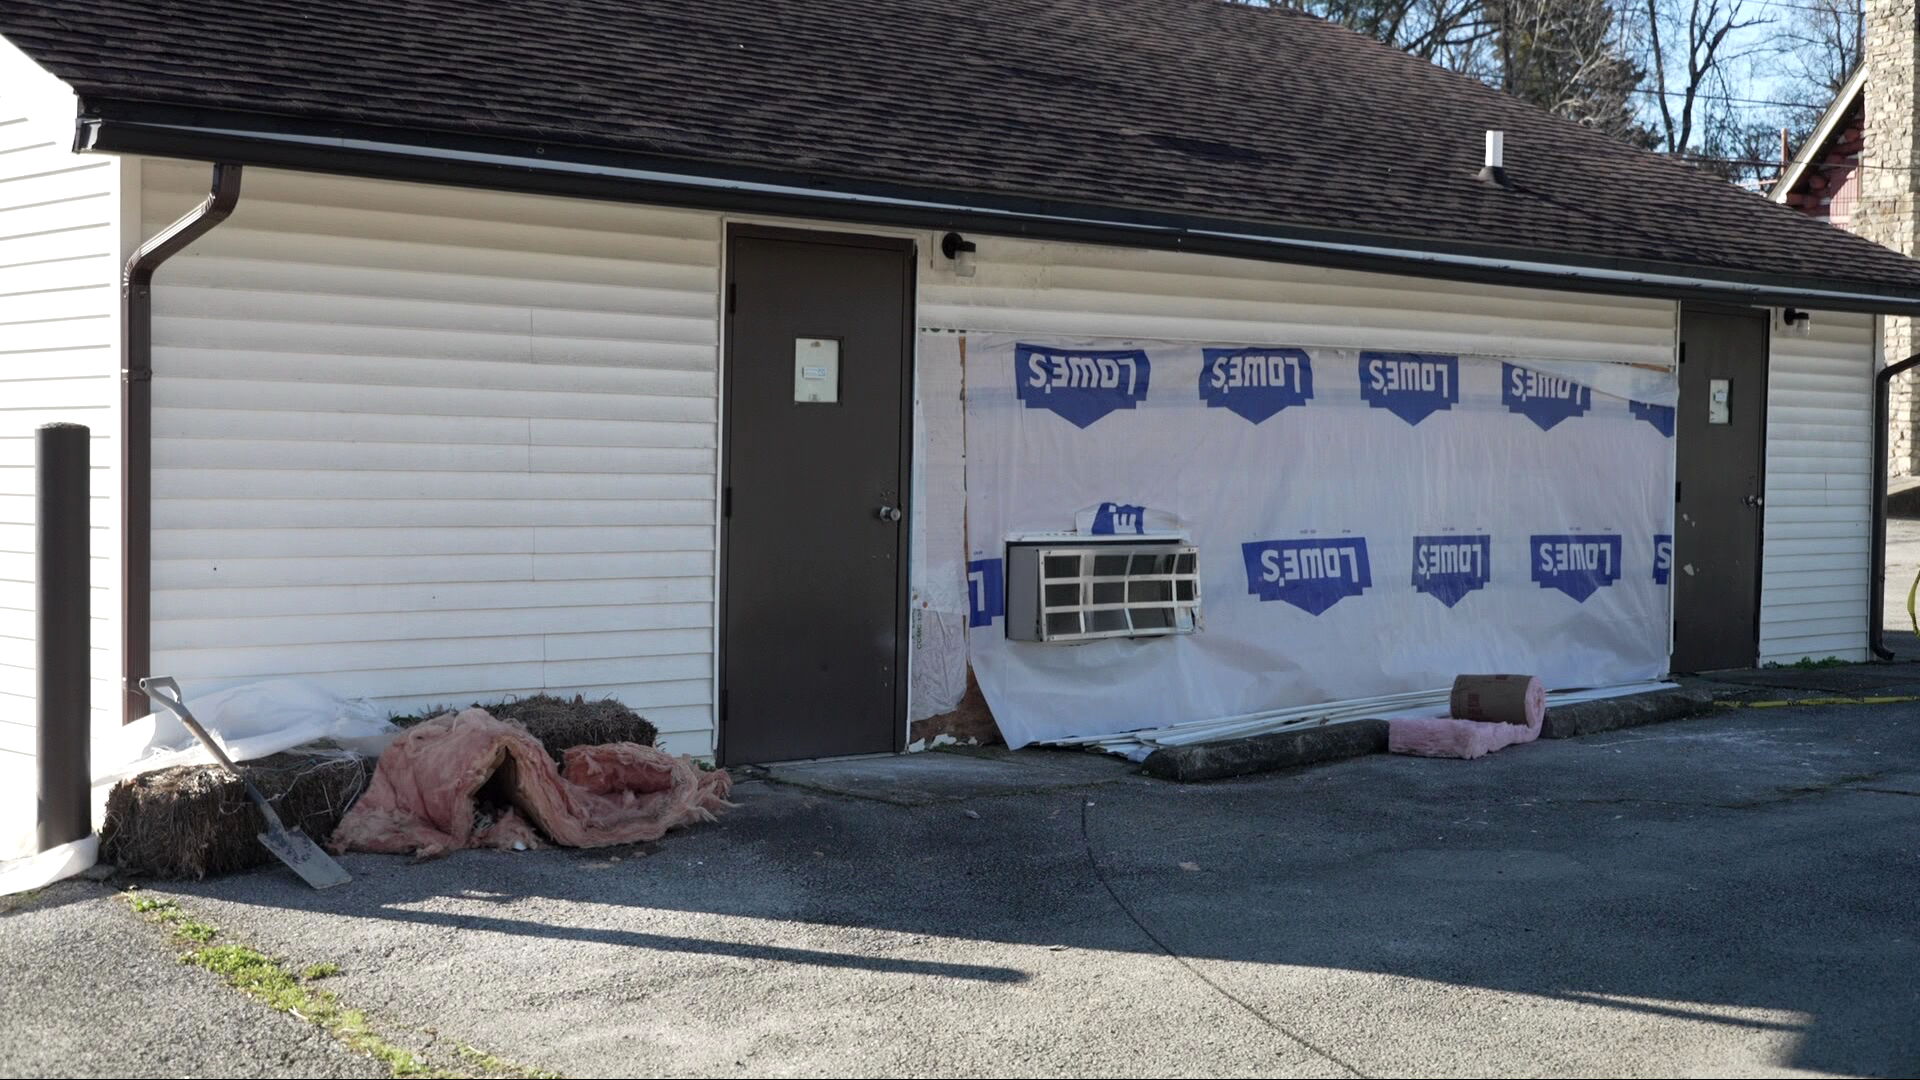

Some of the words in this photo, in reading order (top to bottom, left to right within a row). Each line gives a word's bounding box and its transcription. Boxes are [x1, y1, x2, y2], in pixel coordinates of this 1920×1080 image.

[1029, 353, 1137, 395] LOWE'S
[1211, 355, 1301, 394] LOWE'S
[1369, 359, 1449, 398] LOWE'S
[1260, 546, 1359, 587] LOWE'S
[1418, 544, 1482, 580] LOWE'S
[1539, 542, 1612, 576] LOWE'S
